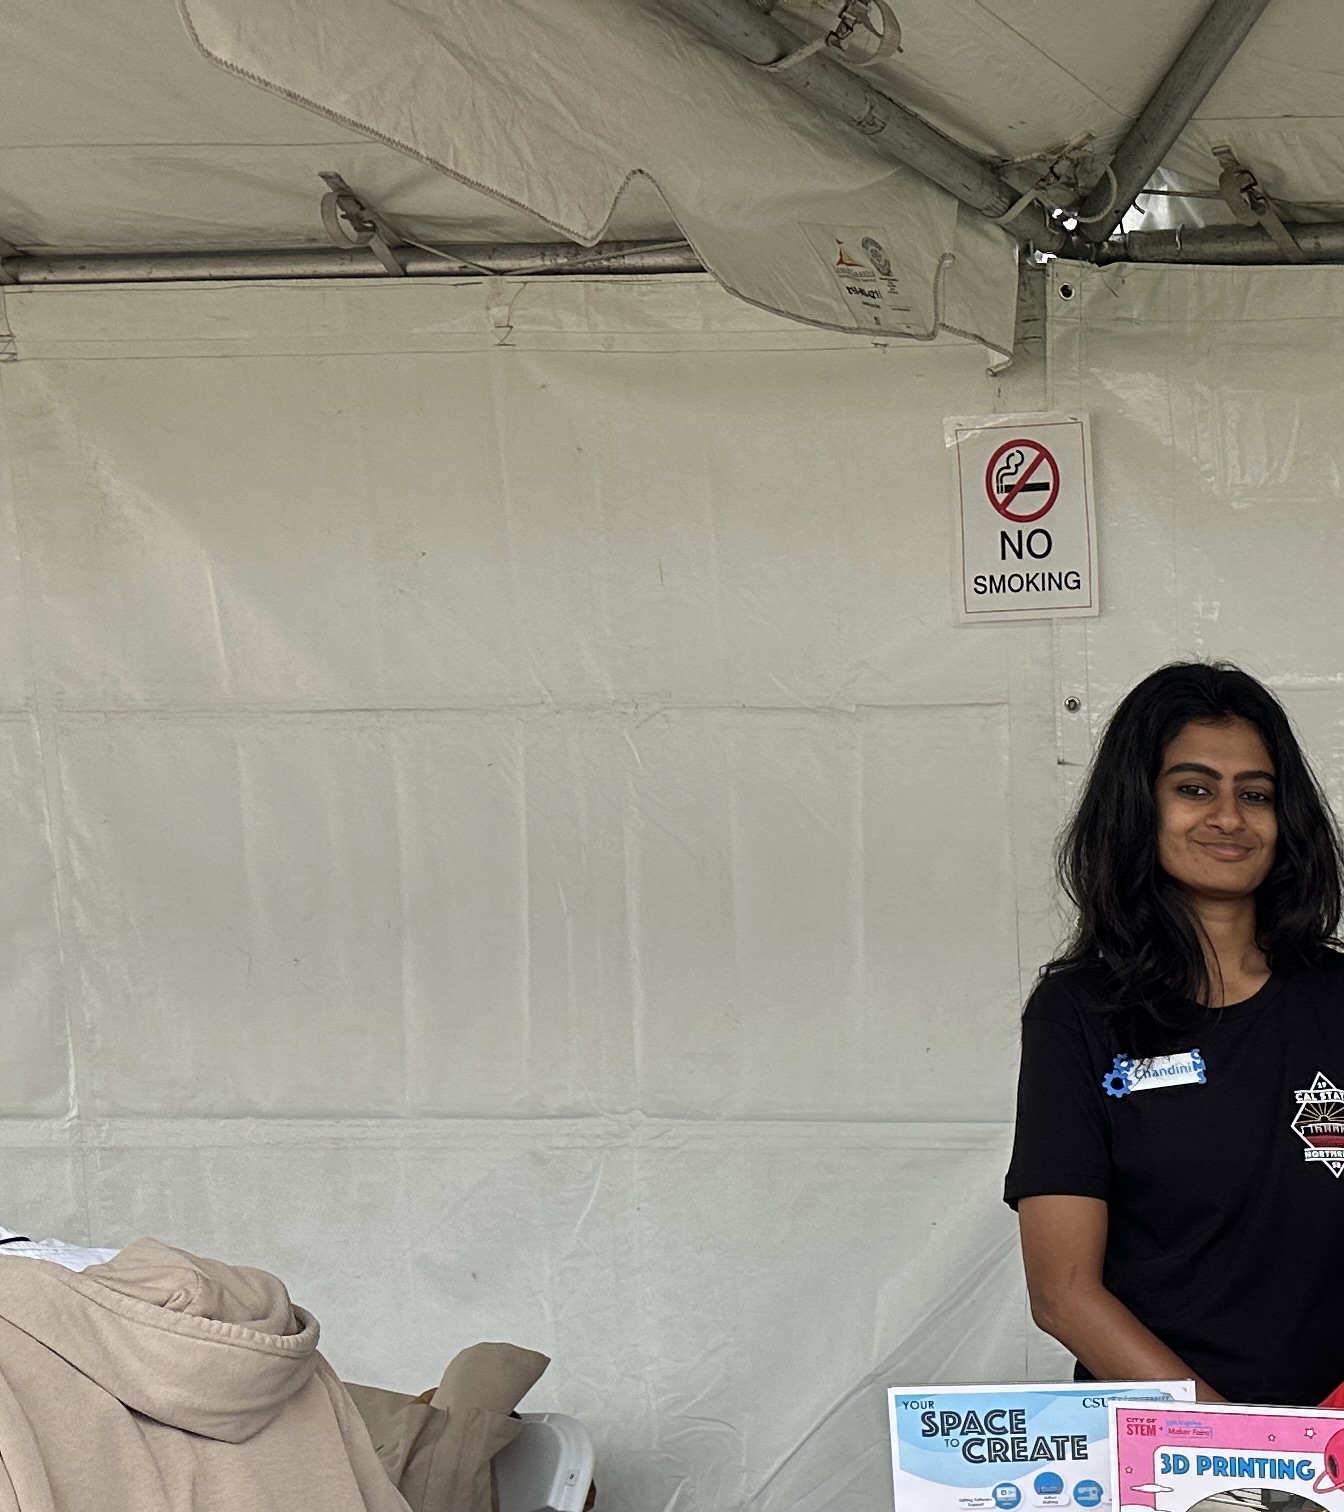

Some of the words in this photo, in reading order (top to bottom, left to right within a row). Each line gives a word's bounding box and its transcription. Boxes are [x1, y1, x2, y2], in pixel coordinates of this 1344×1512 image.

[999, 528, 1053, 561] NO
[973, 569, 1082, 596] SMOKING
[1134, 1062, 1193, 1080] Chandini
[1295, 1092, 1317, 1102] CAL
[902, 1400, 935, 1411] YOUR
[920, 1408, 1027, 1438] SPACE
[1126, 1424, 1157, 1437] STEM
[944, 1438, 960, 1449] TO
[961, 1434, 1089, 1464] CREATE
[1160, 1452, 1190, 1475] 3D
[1196, 1454, 1316, 1481] PRINTING
